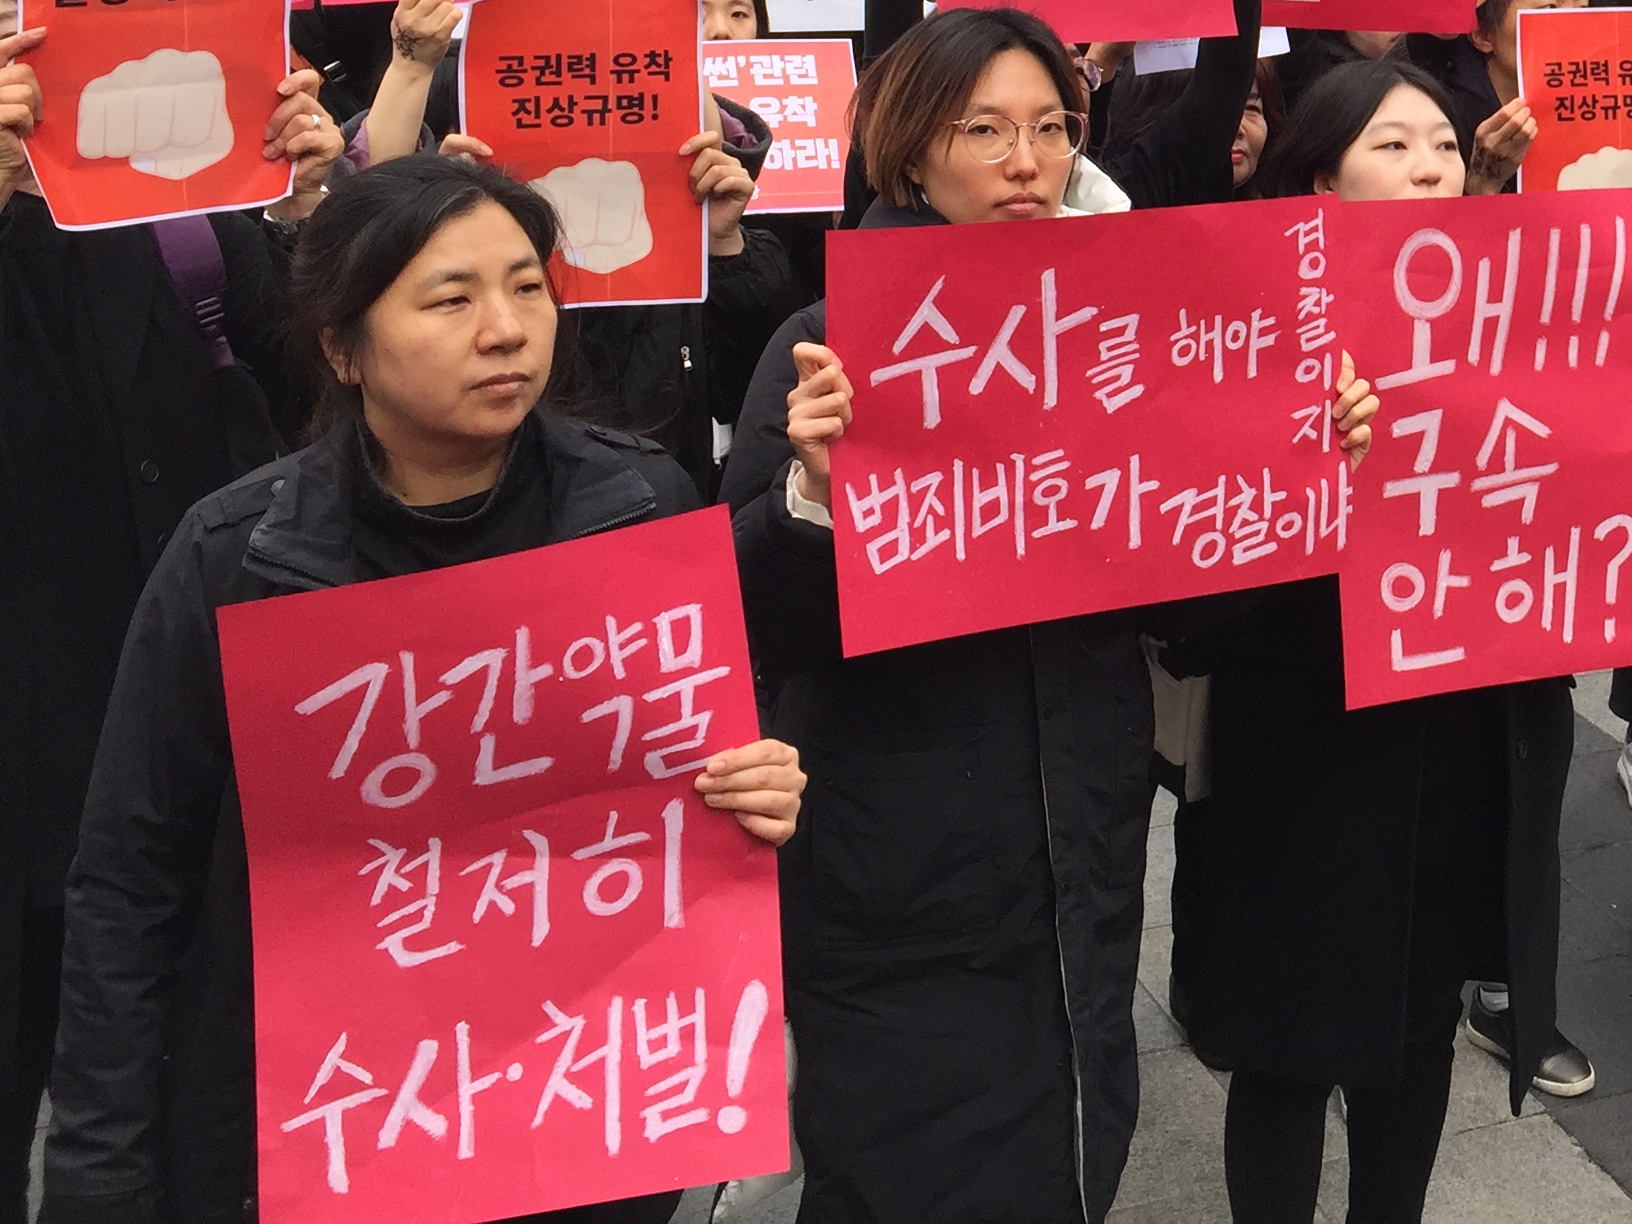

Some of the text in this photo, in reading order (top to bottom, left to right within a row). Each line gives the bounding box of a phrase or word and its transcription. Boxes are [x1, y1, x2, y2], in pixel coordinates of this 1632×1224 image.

[495, 49, 673, 88] 공권력 유착
[750, 54, 819, 86] 관련
[1543, 59, 1611, 88] 공권력
[511, 92, 660, 129] 진상규명!
[749, 95, 818, 129] 유착
[869, 267, 1281, 430] 수사를 해야
[1284, 208, 1338, 453] 경찰이지
[1382, 397, 1561, 536] 구속
[358, 798, 685, 968] 철저히
